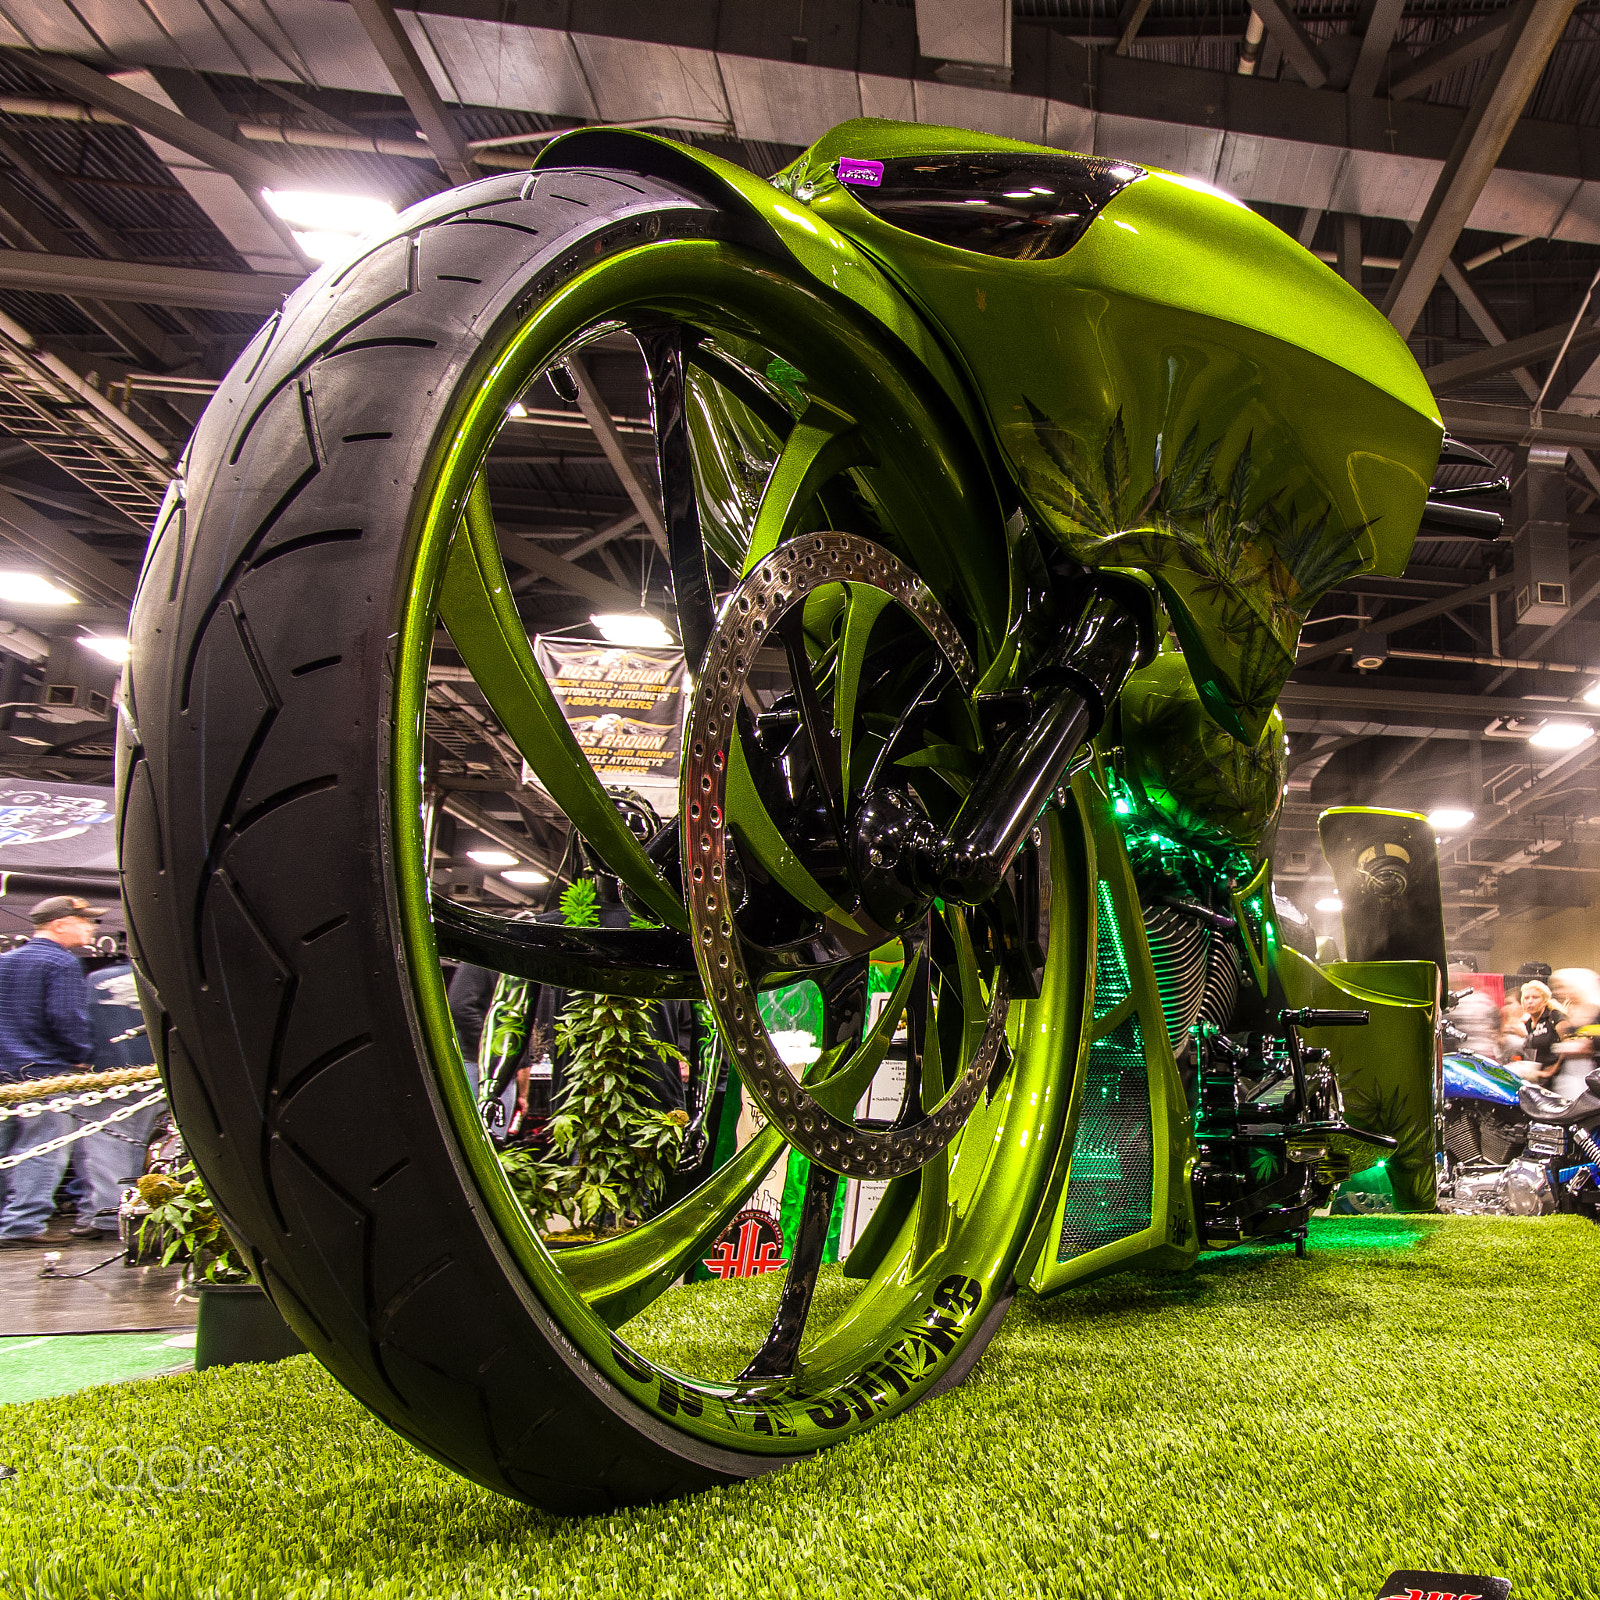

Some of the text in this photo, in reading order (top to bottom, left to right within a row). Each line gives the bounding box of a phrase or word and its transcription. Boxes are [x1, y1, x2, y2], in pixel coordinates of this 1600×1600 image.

[557, 664, 673, 684] RUSS BROWN
[552, 687, 670, 701] MOTORCYCLE ATTORNEYS
[619, 683, 641, 691] JIM
[641, 685, 680, 694] ROMAG
[564, 697, 655, 711] 1-800-4-BIKERS
[598, 734, 668, 750] BROWN
[613, 749, 635, 757] JIM
[636, 750, 675, 759] ROMAG
[608, 756, 665, 767] ATTORNEYS
